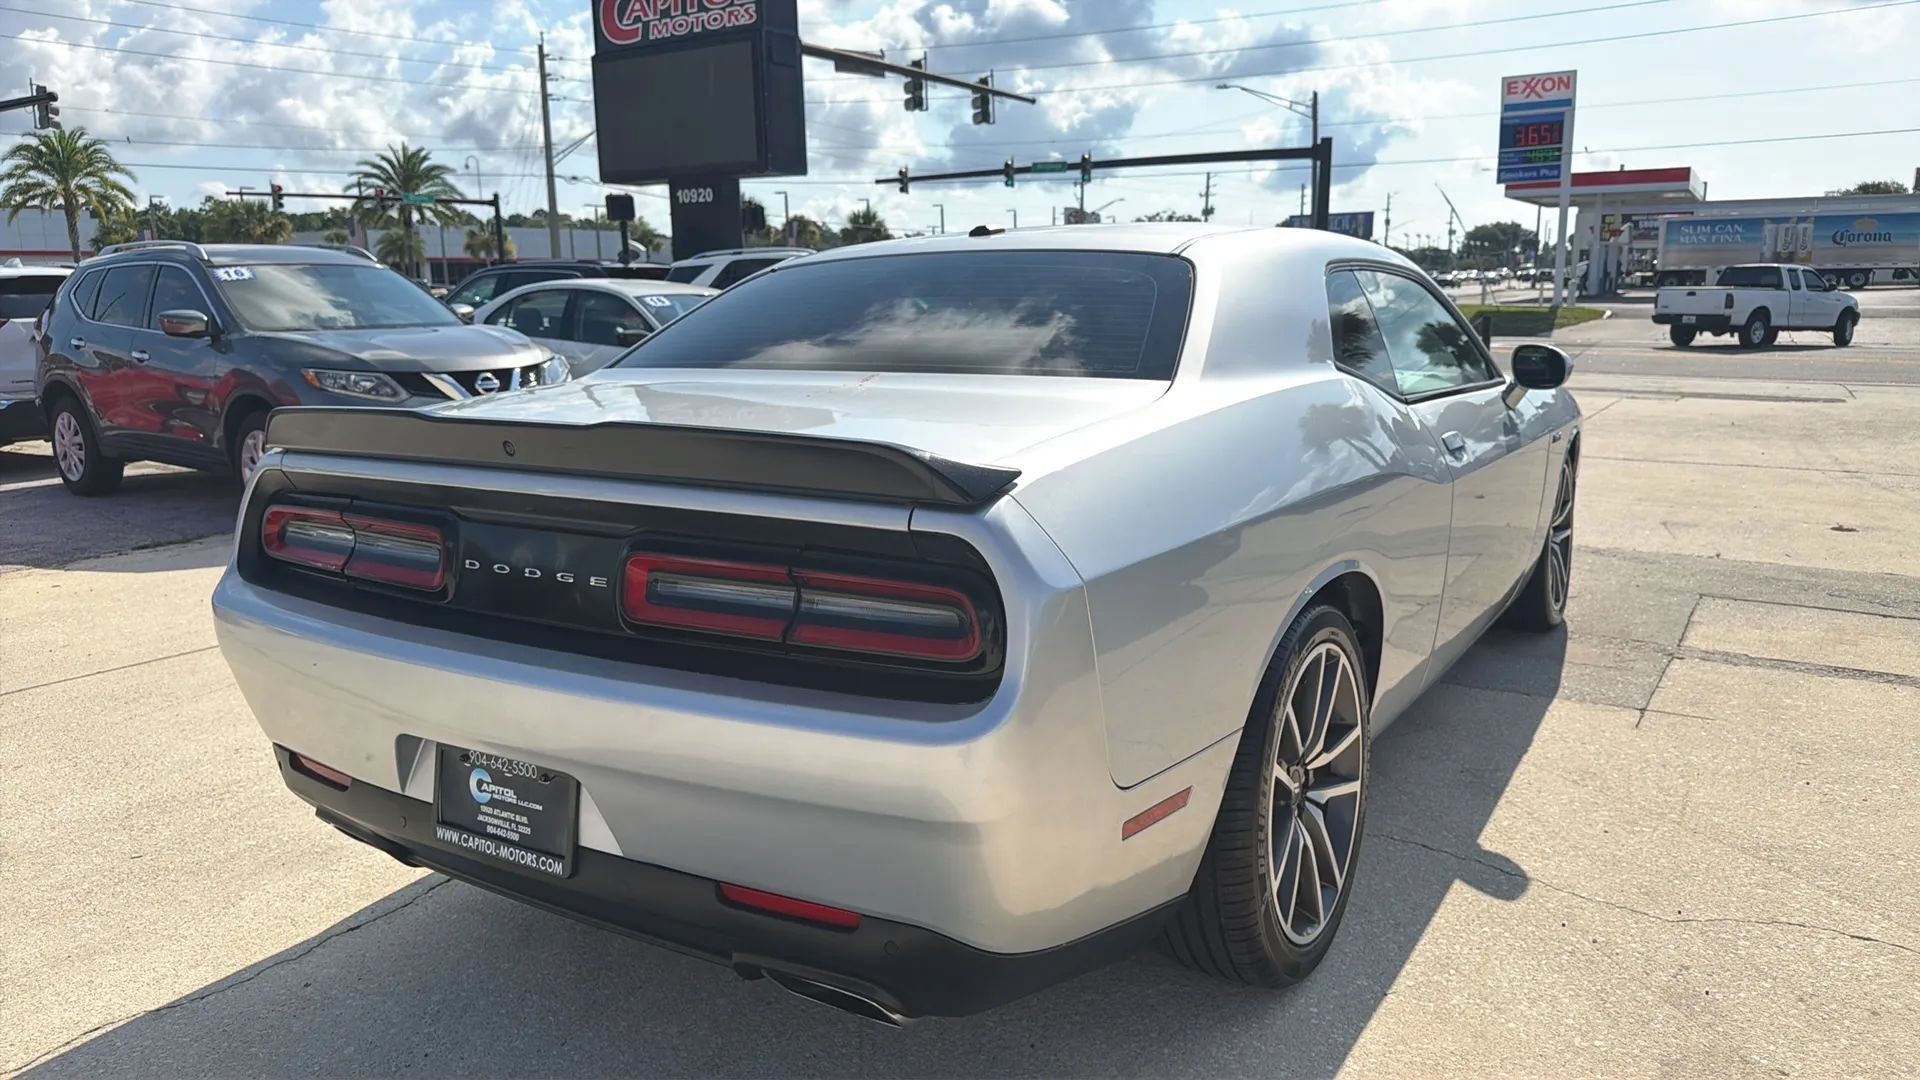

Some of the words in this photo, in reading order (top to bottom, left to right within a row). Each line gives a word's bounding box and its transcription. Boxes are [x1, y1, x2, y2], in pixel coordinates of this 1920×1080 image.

[600, 0, 755, 44] CAPI
[649, 4, 757, 40] MOTORS
[1506, 76, 1570, 99] EXXON
[1540, 168, 1558, 177] Plus
[676, 188, 713, 203] 10920
[1681, 224, 1711, 234] SLIM
[1831, 229, 1893, 247] Corona
[464, 559, 608, 588] DODGE
[468, 751, 538, 779] 904-642-5500
[469, 768, 517, 804] CAPITOL
[436, 826, 563, 875] WWW.CAPITOL-MOTORS.COM
